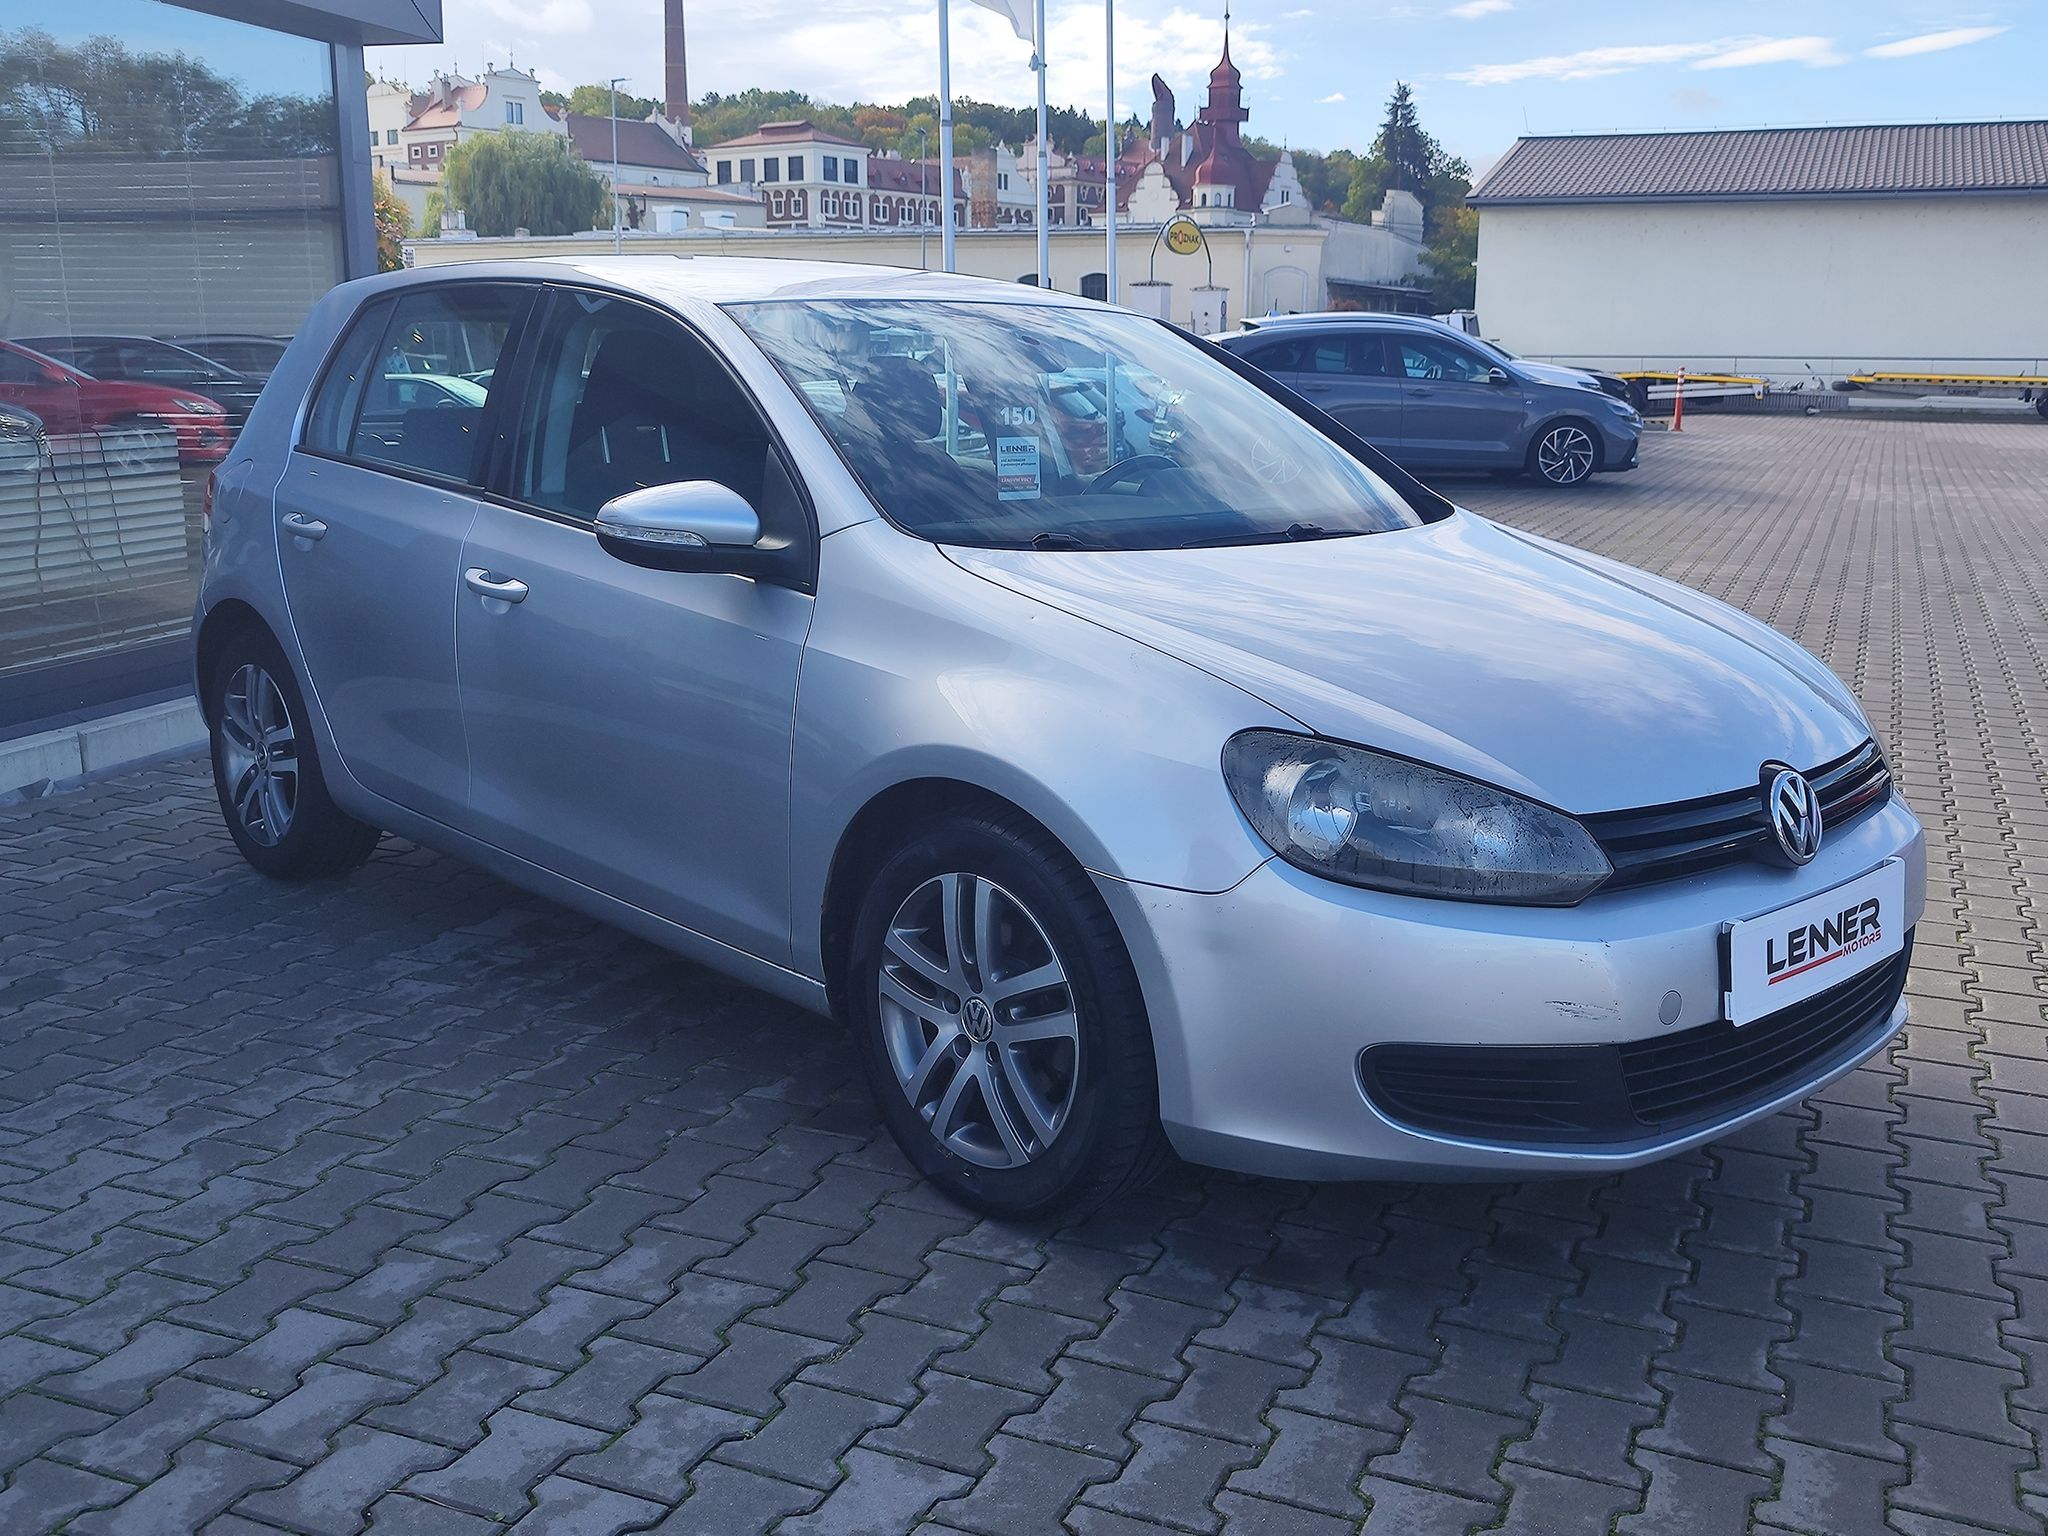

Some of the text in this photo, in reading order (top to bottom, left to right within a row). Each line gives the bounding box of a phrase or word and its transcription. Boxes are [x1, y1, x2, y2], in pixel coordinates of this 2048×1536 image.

[1000, 406, 1036, 426] 150
[1000, 445, 1037, 453] LENNER
[1766, 897, 1881, 975] LENNER
[1842, 928, 1881, 957] MOTORS
